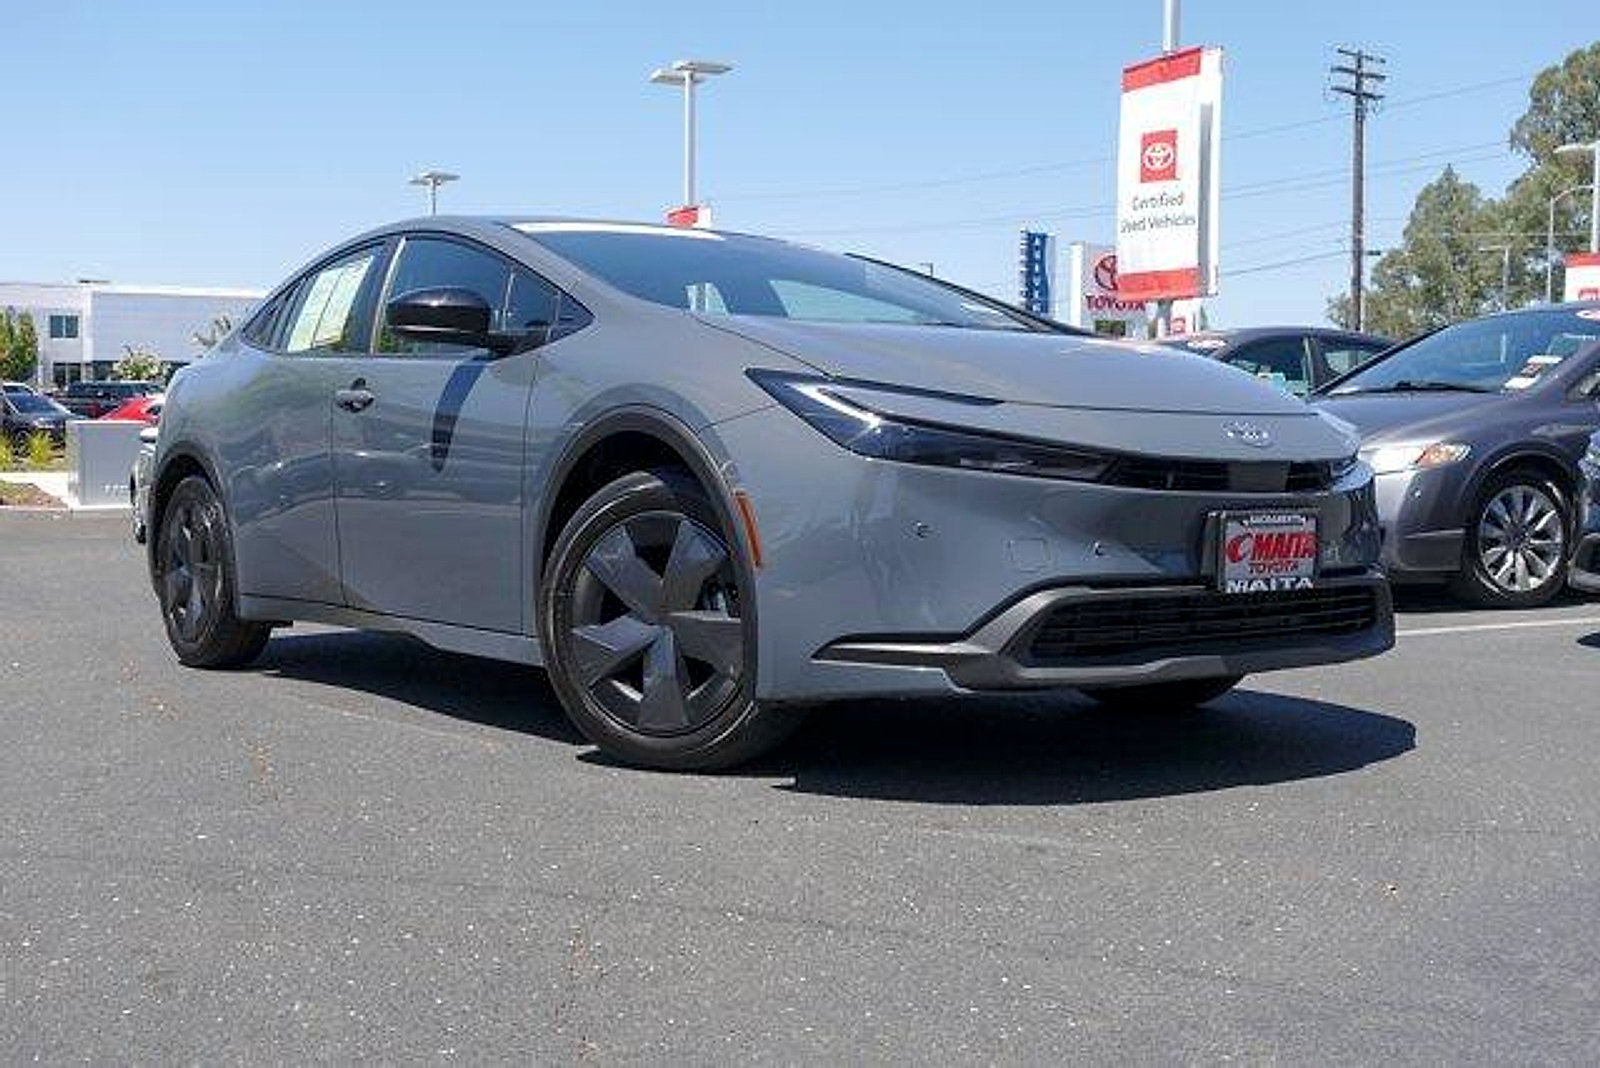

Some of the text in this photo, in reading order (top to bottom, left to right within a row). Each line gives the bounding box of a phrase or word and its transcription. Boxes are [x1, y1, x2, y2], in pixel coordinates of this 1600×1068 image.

[1132, 191, 1184, 211] Certified
[1148, 213, 1196, 229] Vehicles
[1249, 532, 1319, 561] MAITA
[1248, 561, 1299, 575] TOYOTA
[1225, 578, 1314, 594] MAITA
